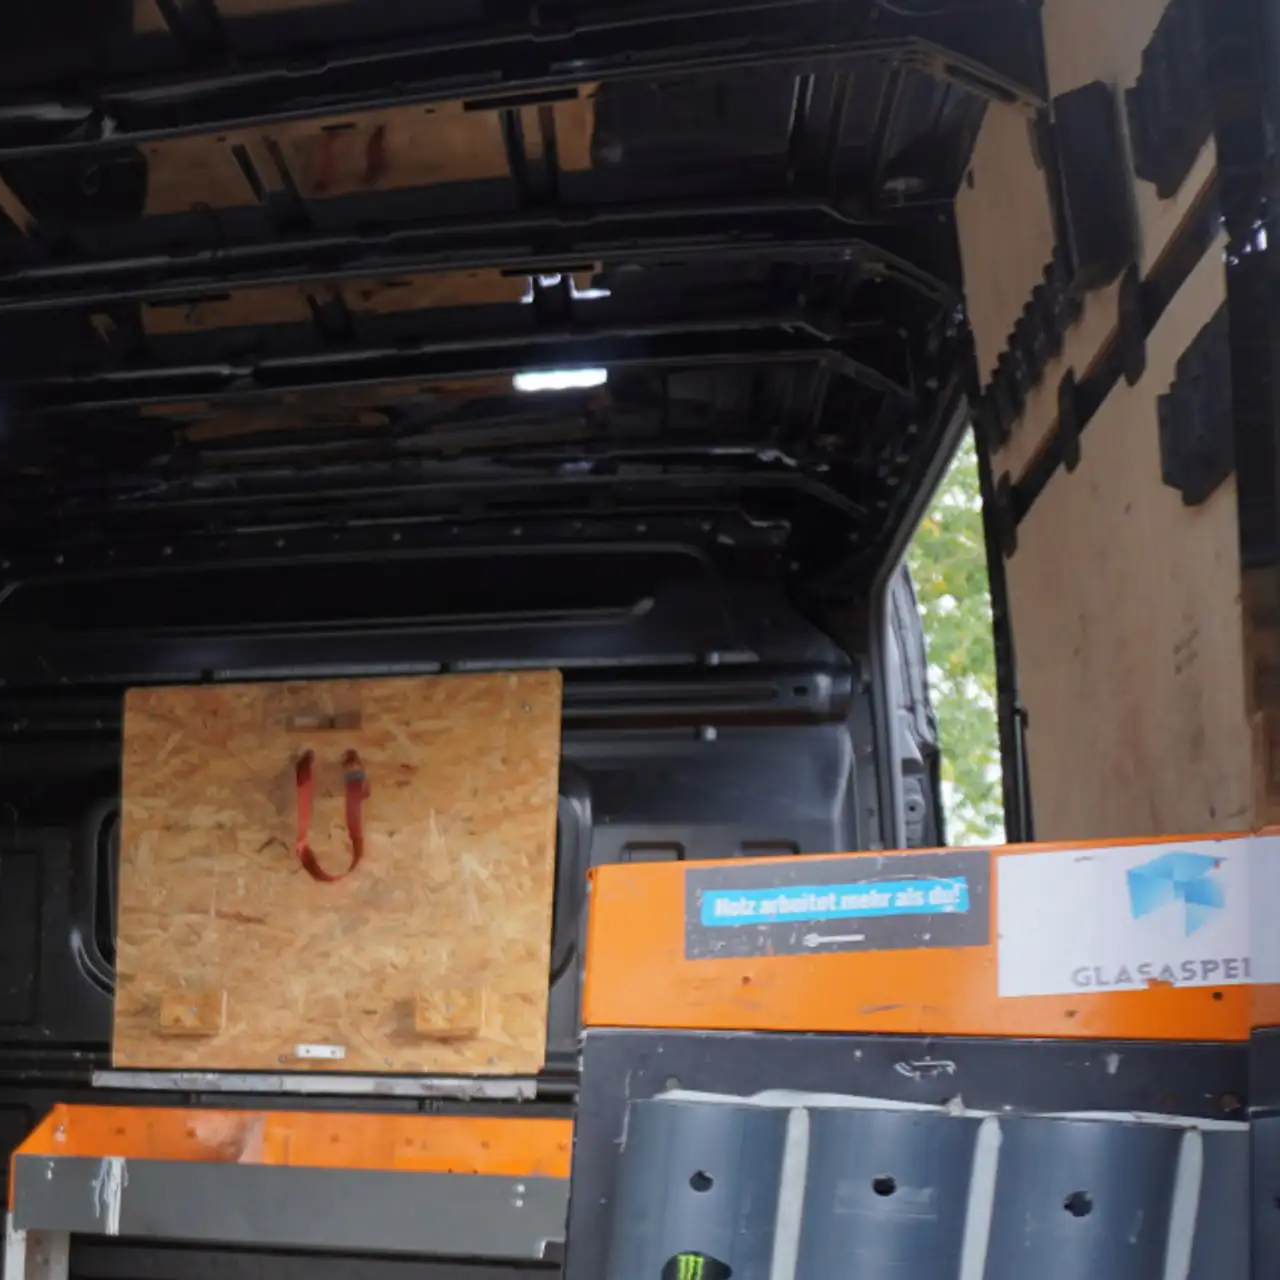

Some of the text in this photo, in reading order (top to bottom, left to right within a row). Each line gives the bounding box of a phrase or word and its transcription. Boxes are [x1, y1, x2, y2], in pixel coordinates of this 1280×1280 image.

[714, 882, 961, 917] Holz arbeitet mehr als du!
